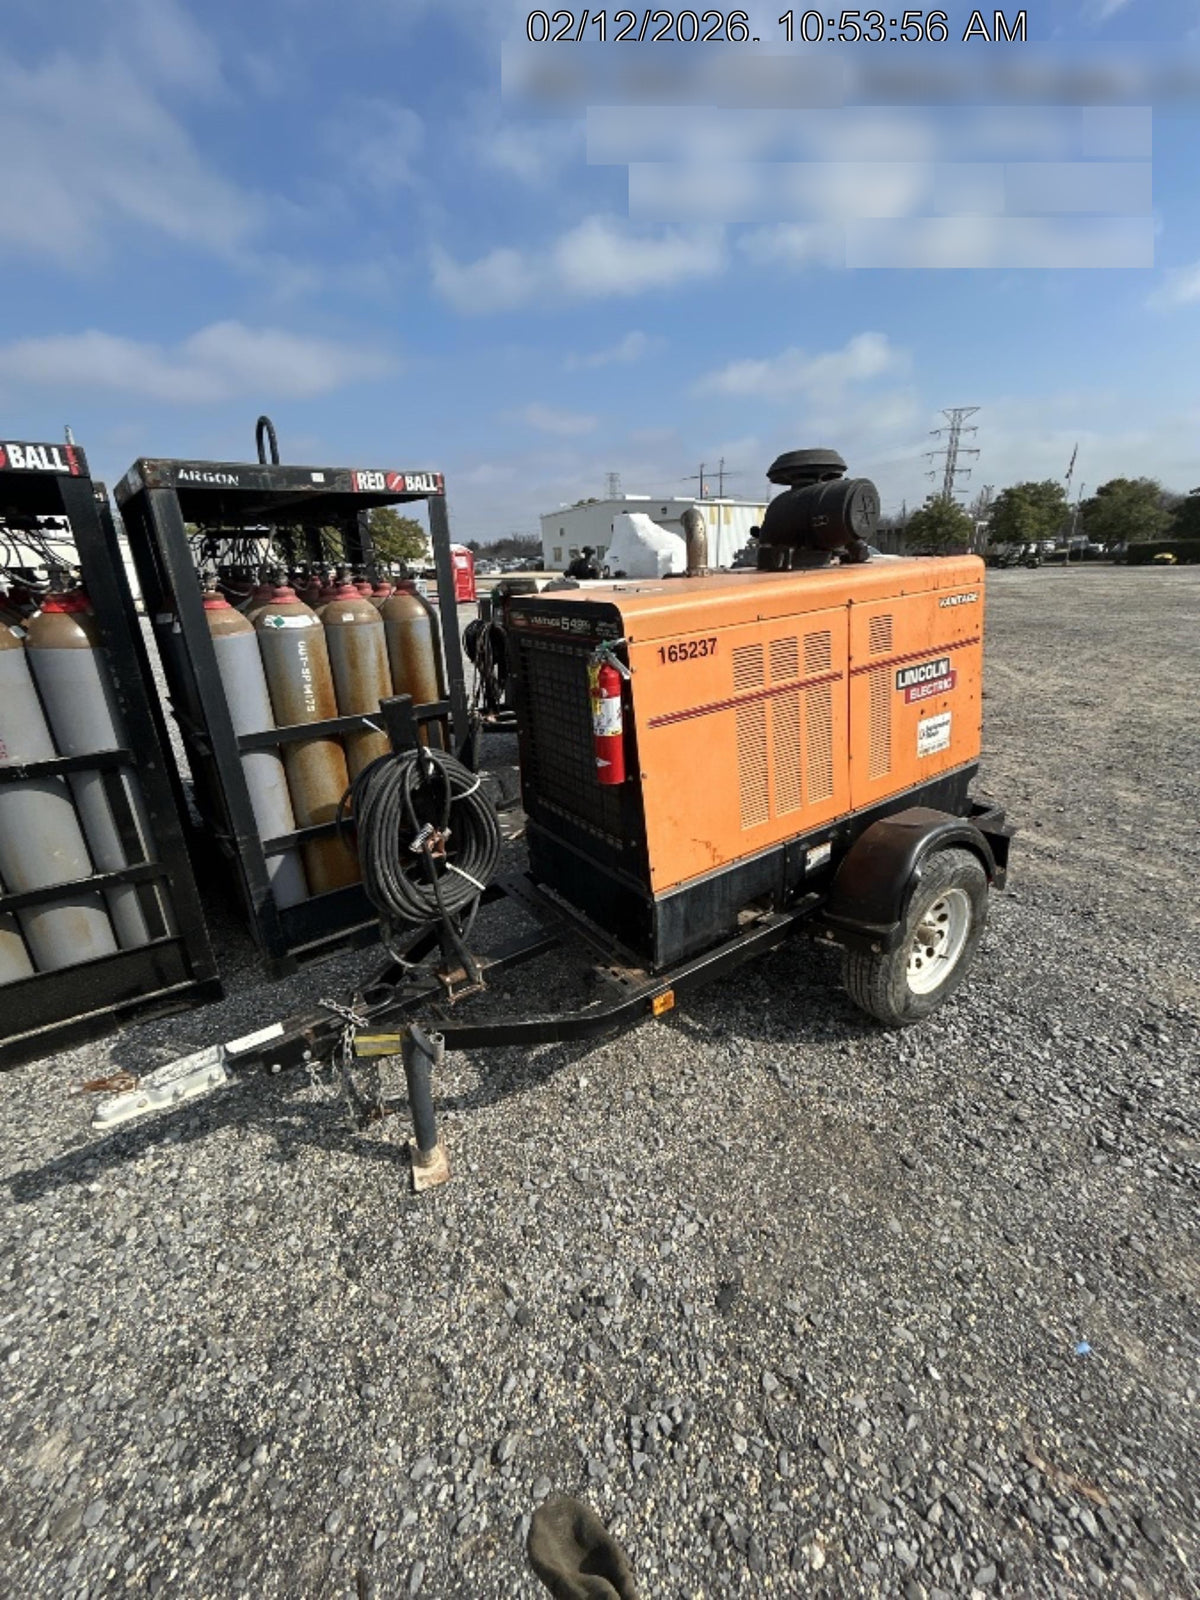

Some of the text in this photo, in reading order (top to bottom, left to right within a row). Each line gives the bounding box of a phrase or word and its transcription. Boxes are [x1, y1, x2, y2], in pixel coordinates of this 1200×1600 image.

[6, 443, 70, 472] BALL
[178, 468, 240, 486] ARGON
[357, 471, 438, 492] RED BALL
[657, 637, 717, 664] 165237
[897, 660, 949, 688] LINCOLN
[909, 677, 952, 700] ELECTRIC
